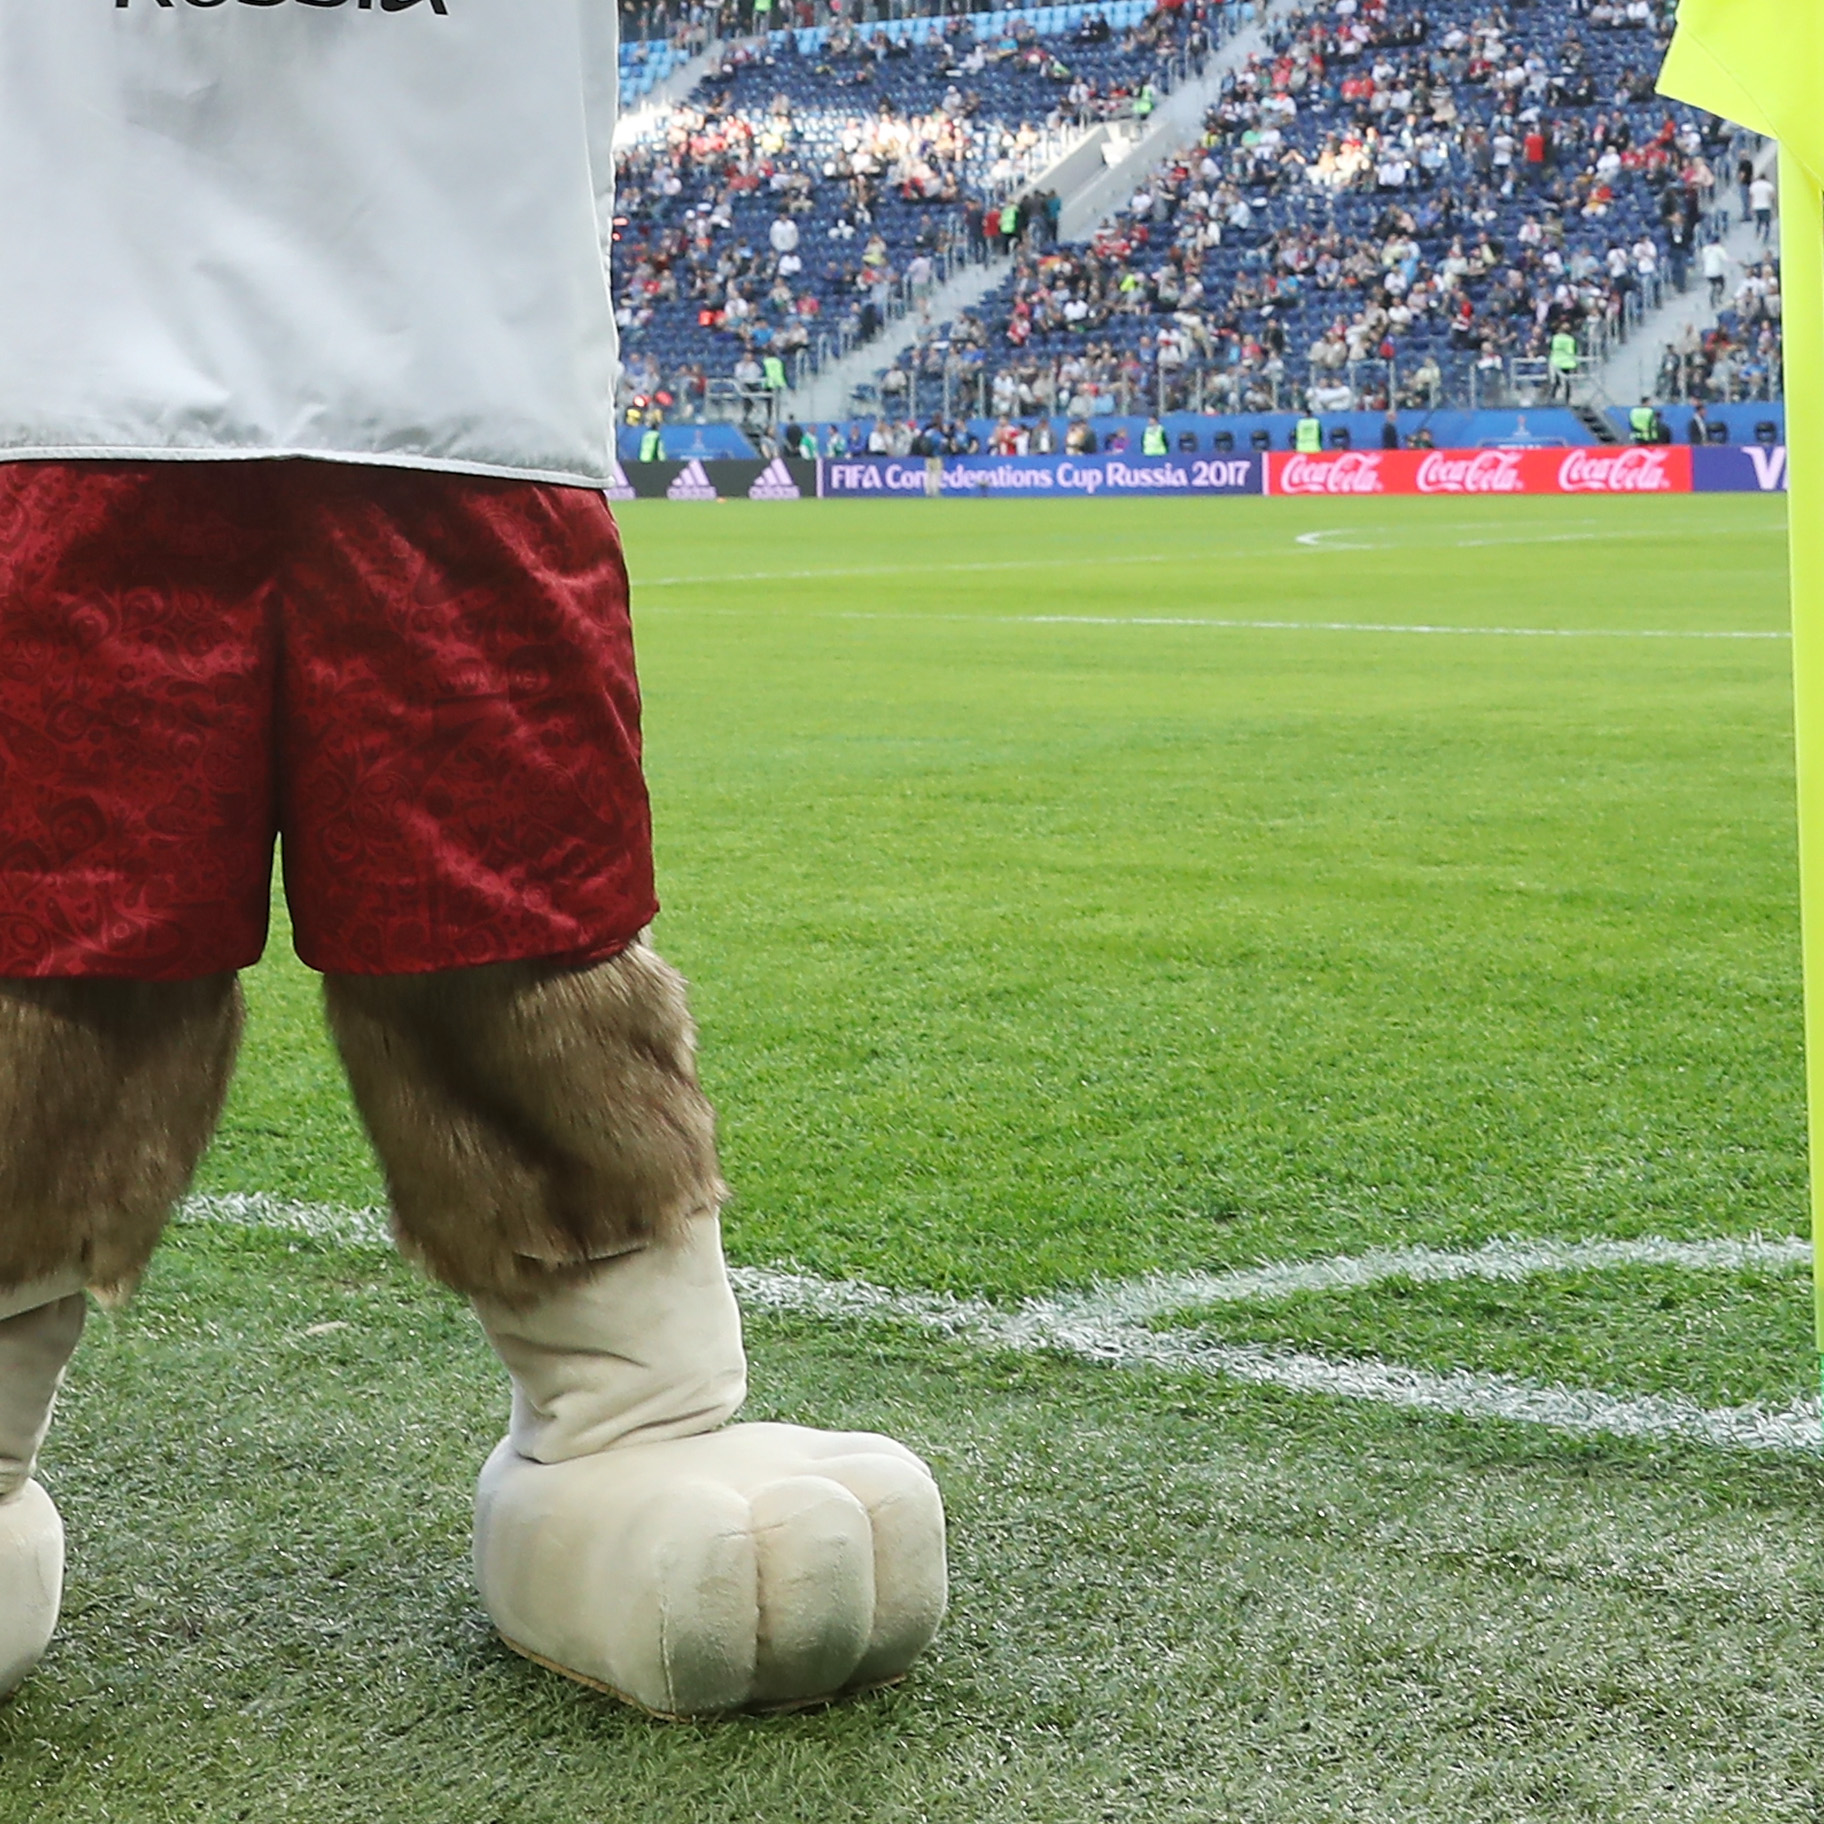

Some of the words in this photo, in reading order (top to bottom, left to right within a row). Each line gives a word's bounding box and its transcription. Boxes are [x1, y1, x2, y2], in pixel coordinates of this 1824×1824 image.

[831, 464, 882, 489] FIFA
[885, 461, 1054, 490] Conederations
[1056, 462, 1103, 494] Cup
[1106, 461, 1188, 487] Russia
[1192, 460, 1252, 487] 2017
